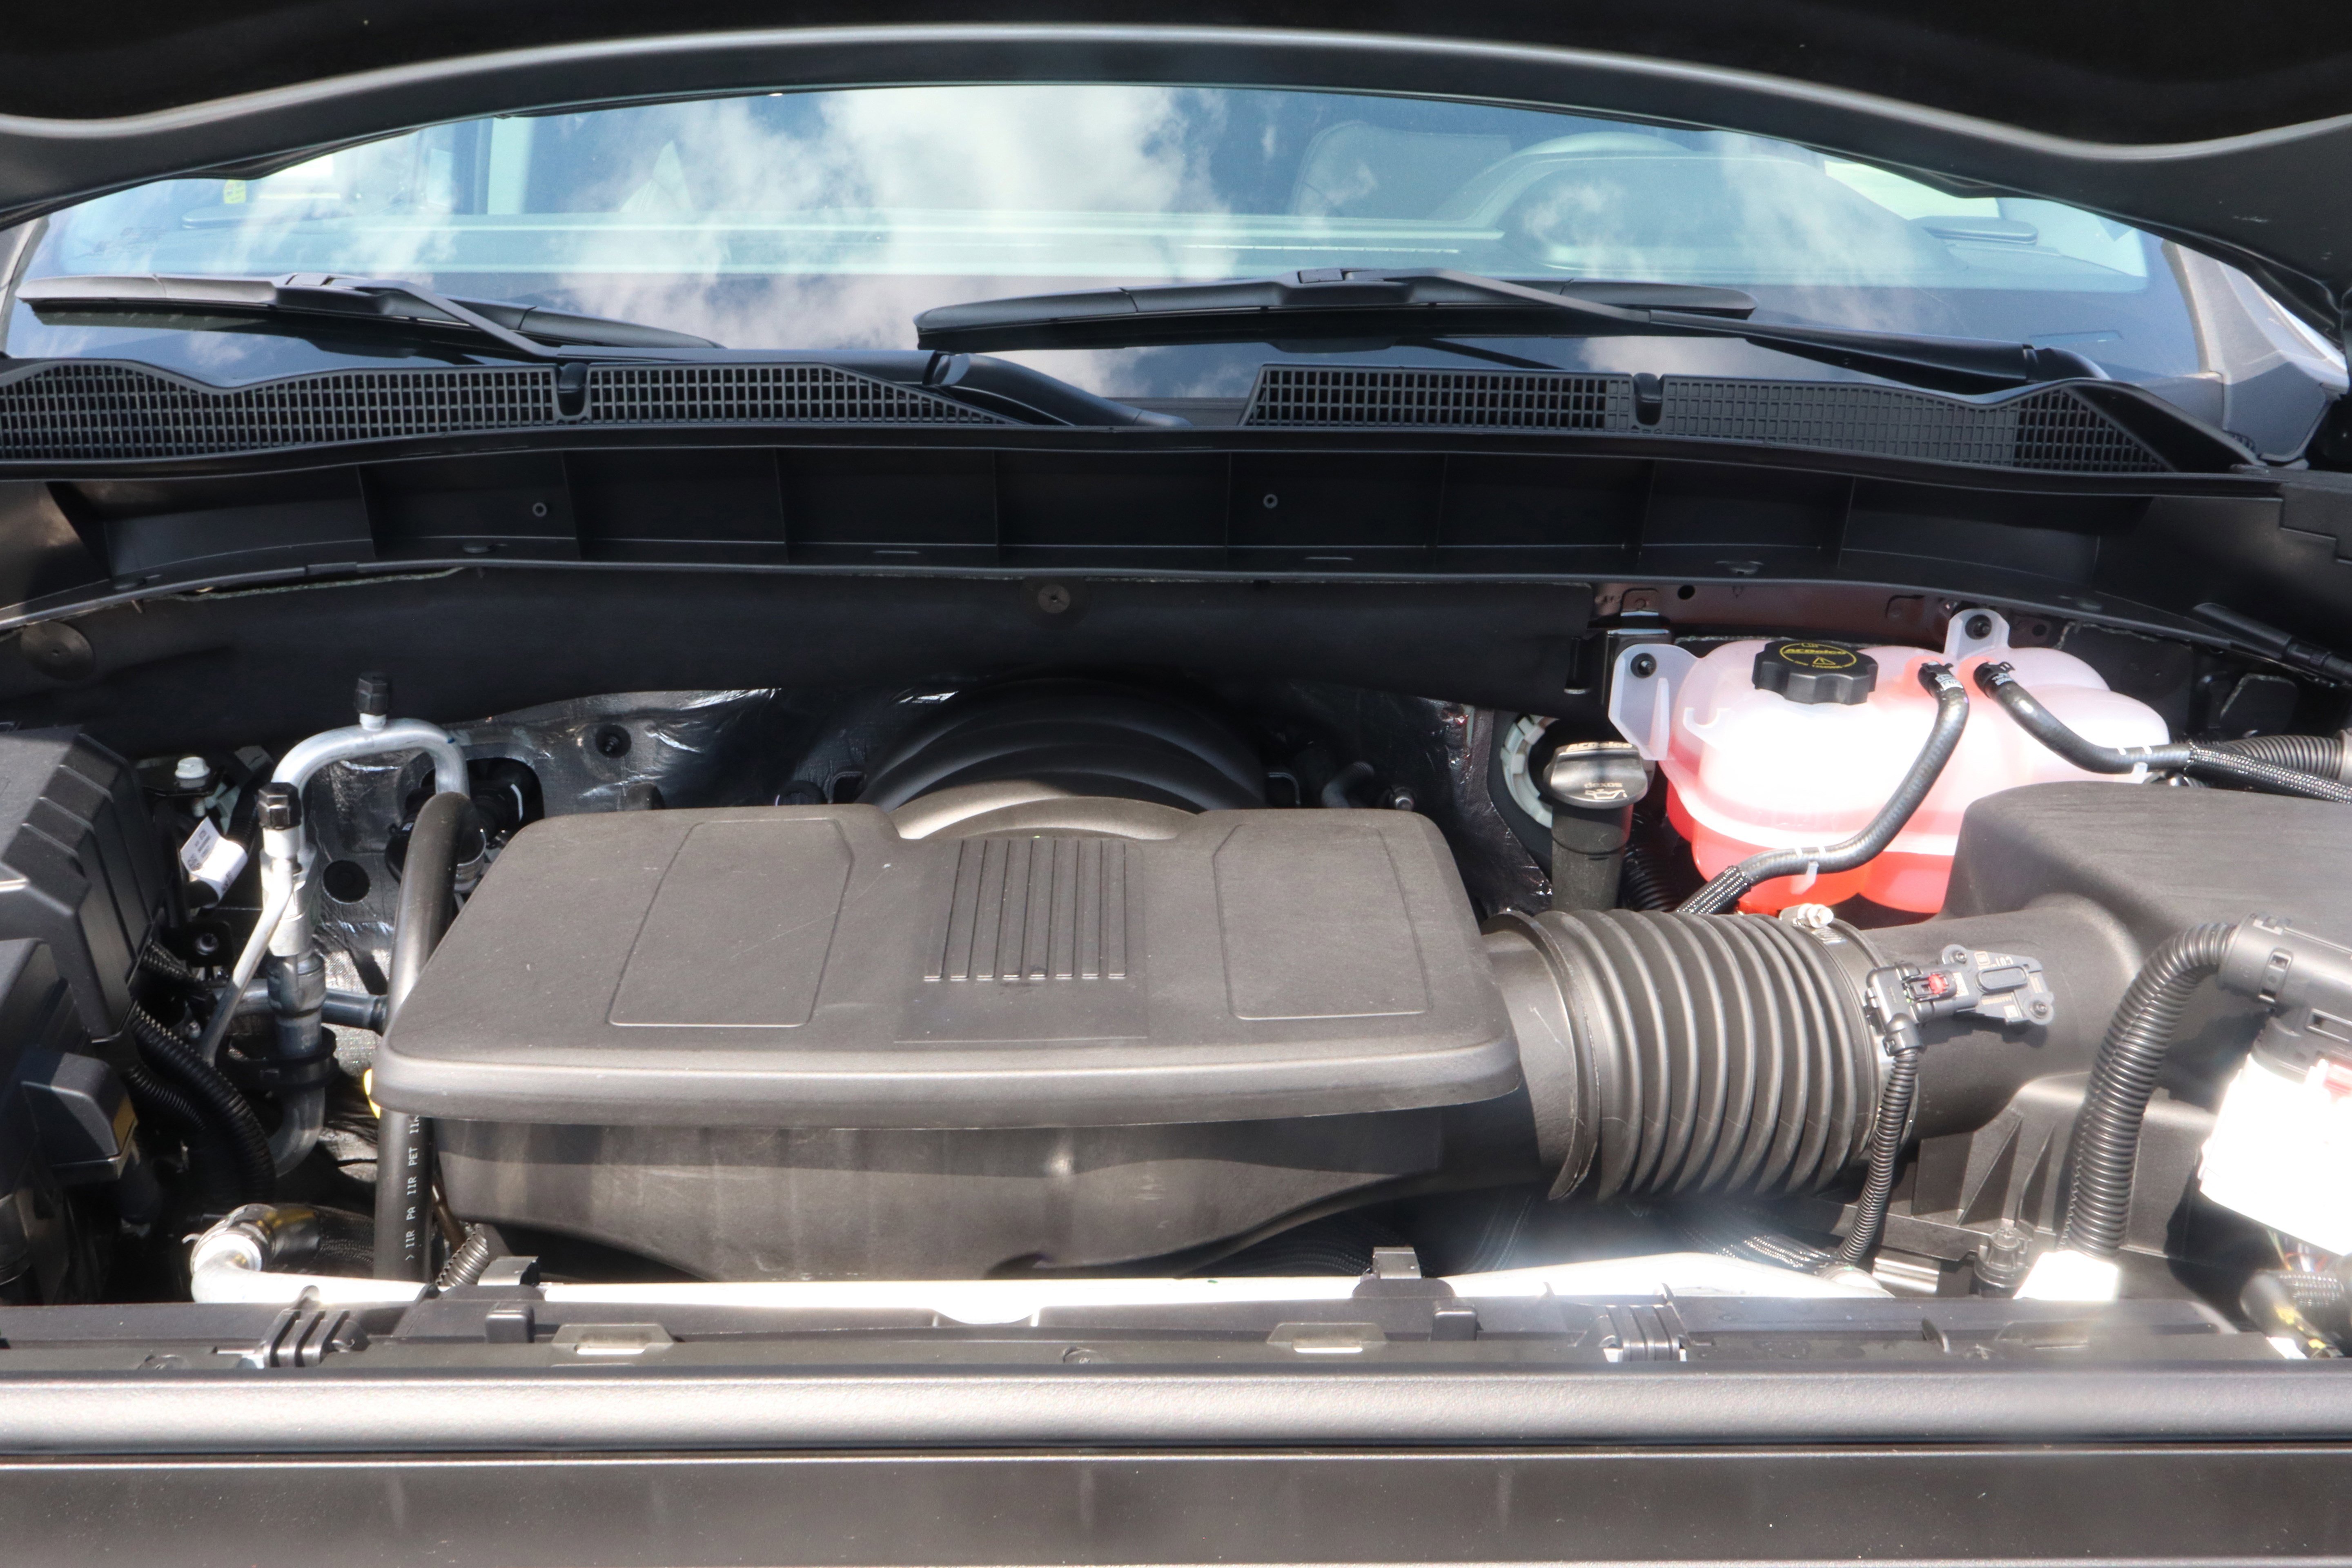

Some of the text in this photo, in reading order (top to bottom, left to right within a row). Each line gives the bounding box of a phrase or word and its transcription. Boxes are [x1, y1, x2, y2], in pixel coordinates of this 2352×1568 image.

[1566, 741, 1633, 752] ACDelco
[408, 1147, 418, 1167] PET
[406, 1206, 416, 1221] PA
